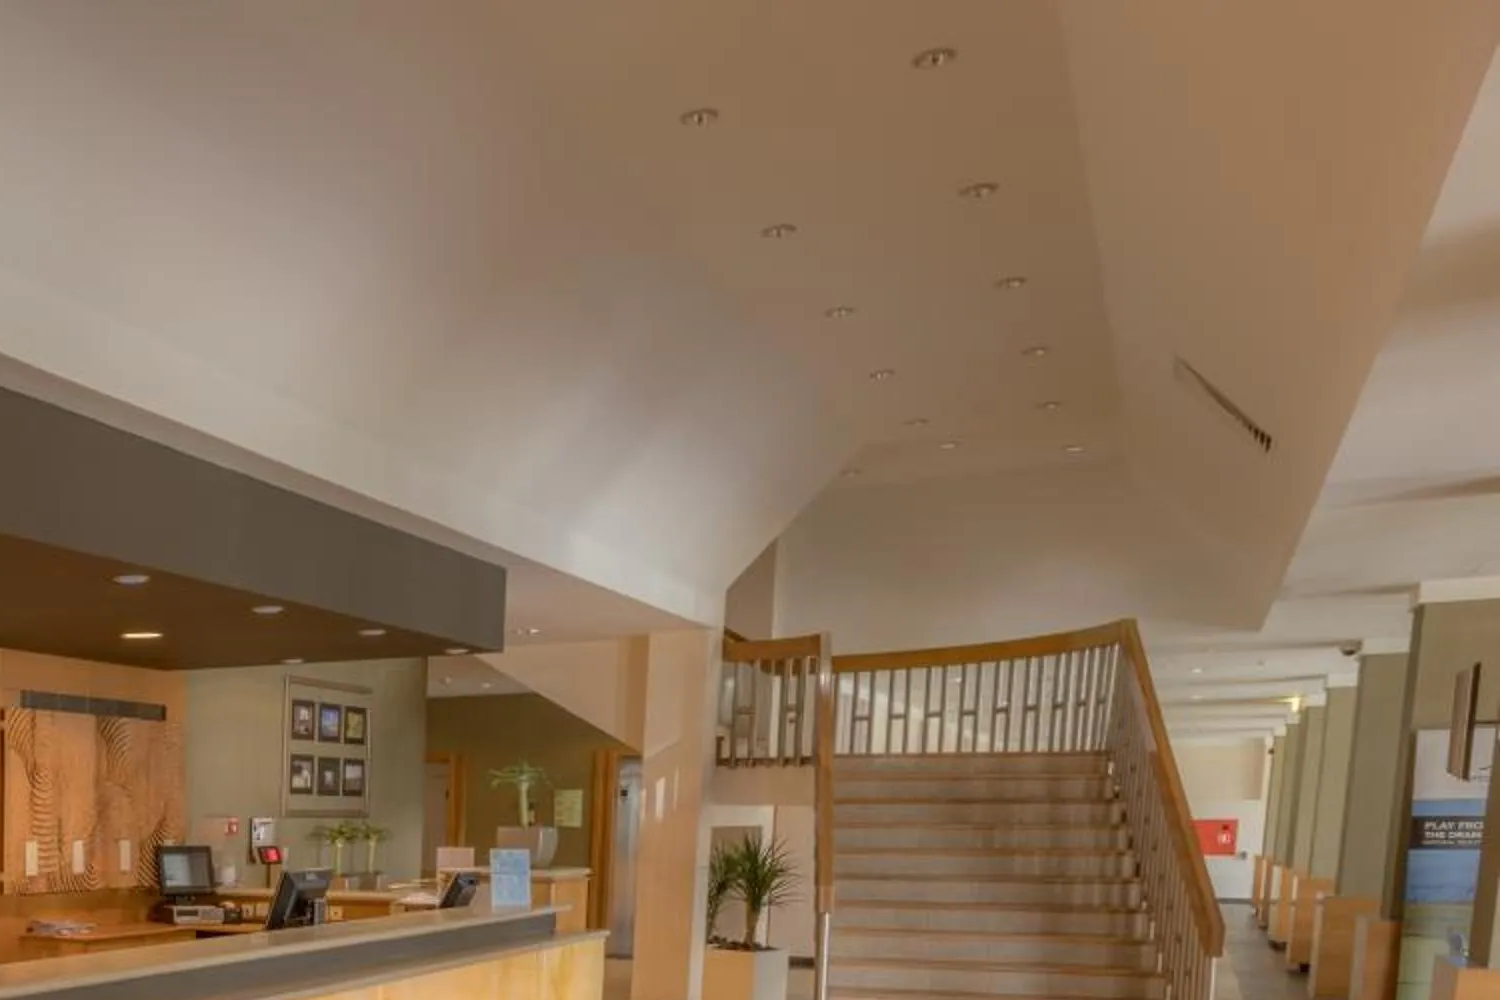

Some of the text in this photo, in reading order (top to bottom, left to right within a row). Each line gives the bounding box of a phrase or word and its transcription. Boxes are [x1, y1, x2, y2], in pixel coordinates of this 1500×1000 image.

[1424, 821, 1484, 830] PLAY FRO
[1425, 831, 1446, 839] THE
